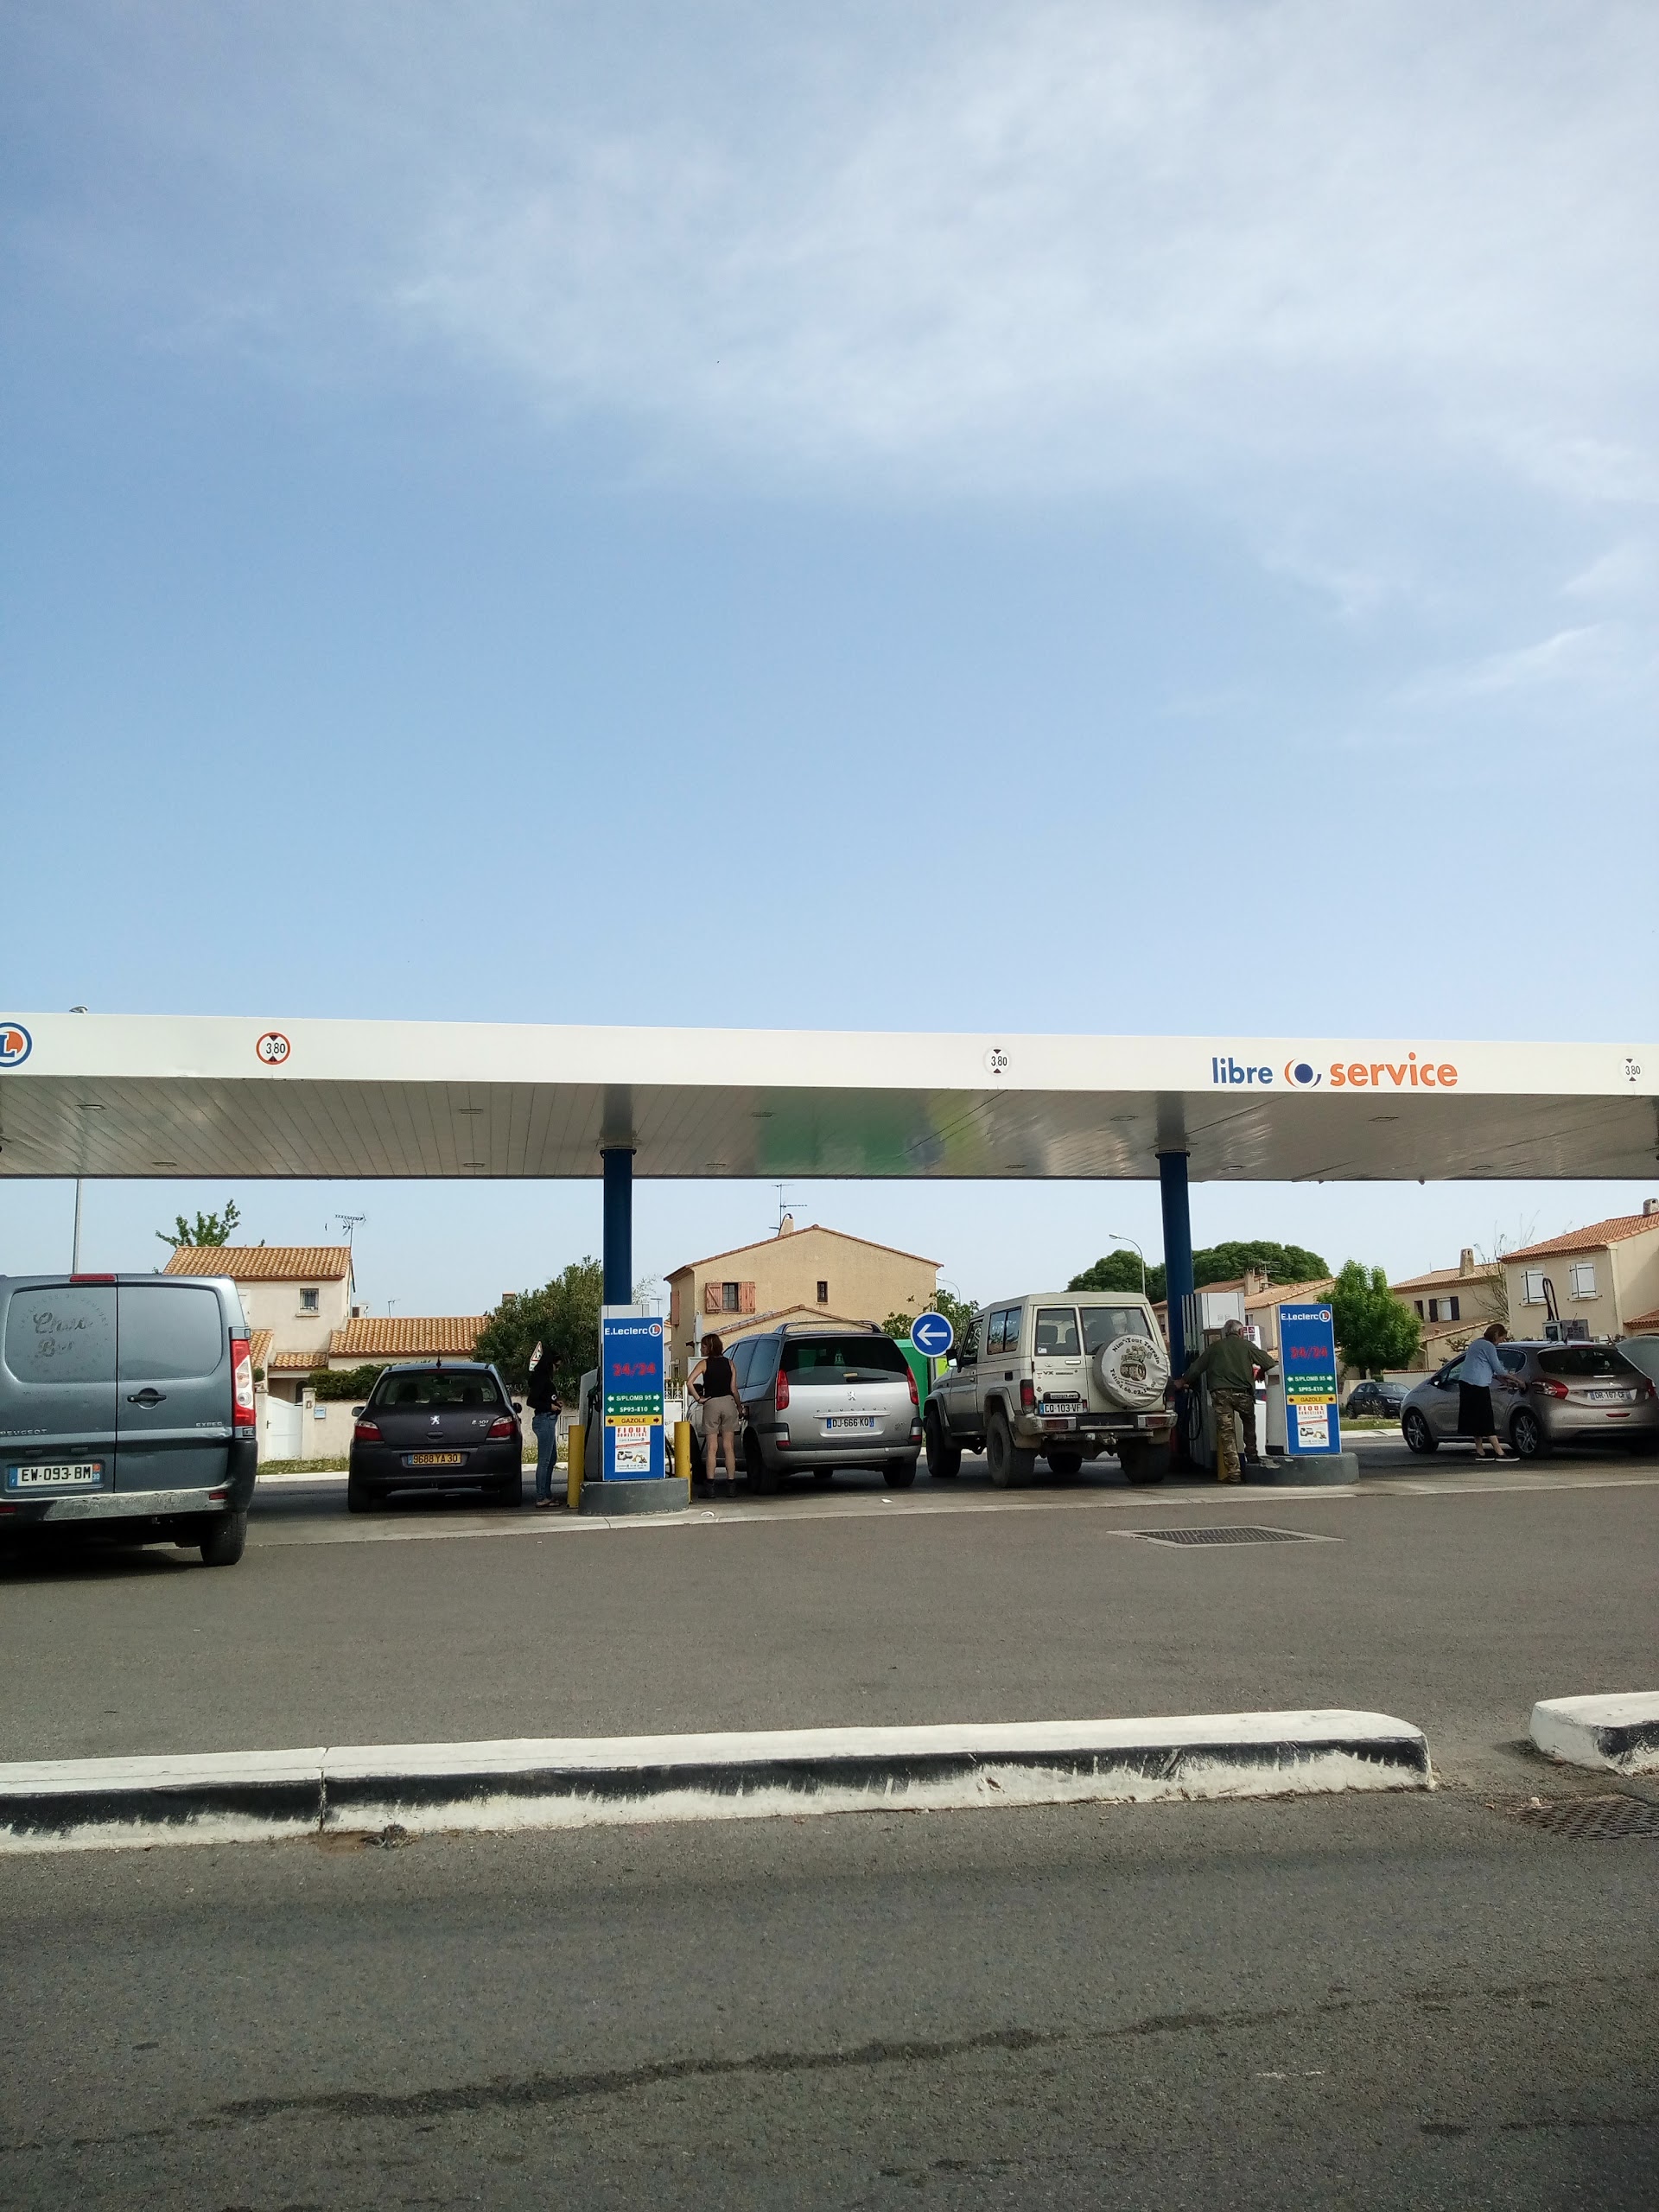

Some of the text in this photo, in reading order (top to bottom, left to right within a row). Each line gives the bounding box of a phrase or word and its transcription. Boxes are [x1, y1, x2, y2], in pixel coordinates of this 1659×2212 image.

[1211, 1052, 1459, 1087] libre service
[604, 1326, 648, 1336] E.Leclerc
[1290, 1345, 1328, 1359] 24/24
[612, 1362, 656, 1376] 24/24
[1045, 1403, 1082, 1413] CQ-103-VF
[413, 1453, 458, 1464] 9688 YA 30
[21, 1465, 92, 1482] EW-093-BM
